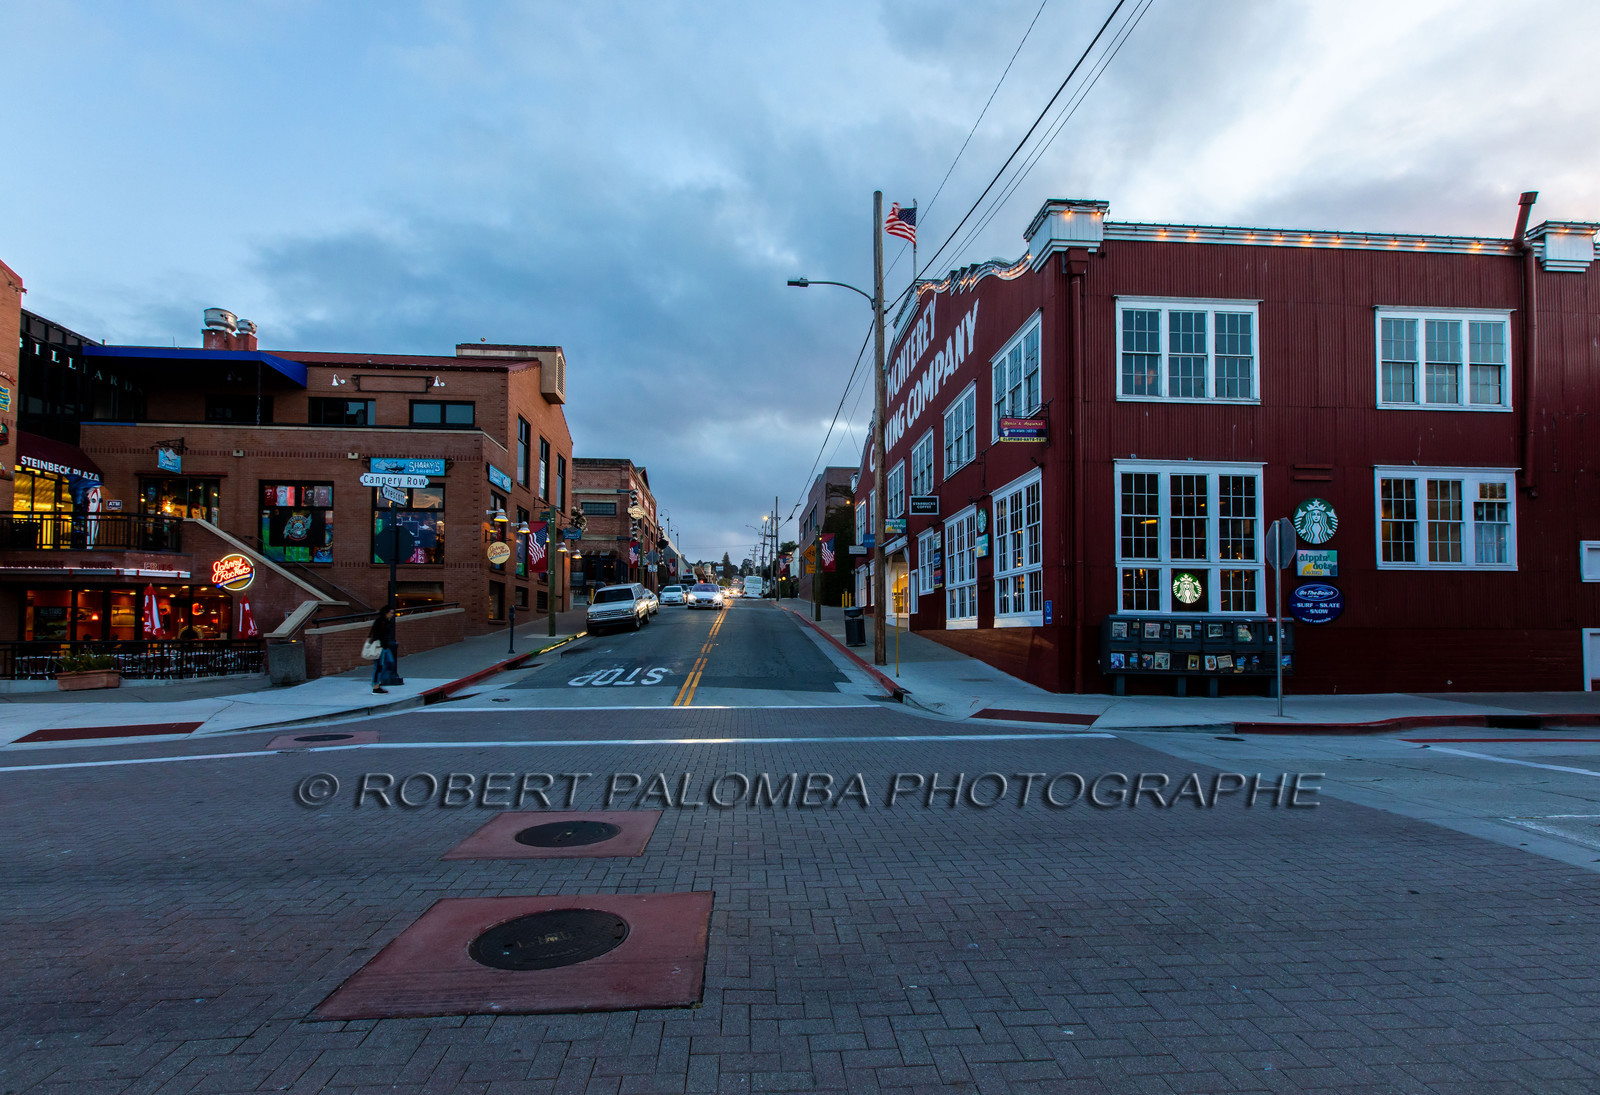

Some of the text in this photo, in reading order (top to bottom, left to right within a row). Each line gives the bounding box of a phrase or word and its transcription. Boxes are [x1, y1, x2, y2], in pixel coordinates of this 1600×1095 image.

[886, 293, 937, 408] MONTEREY
[906, 297, 979, 429] COMPANY
[20, 455, 71, 475] STEINBECK
[408, 461, 441, 472] SHARKY'S
[363, 474, 426, 487] Cannery Row
[385, 486, 406, 504] Prescott
[212, 557, 245, 583] Johnny
[217, 565, 251, 583] Rockets
[1312, 561, 1333, 570] dots
[567, 667, 671, 687] STOP
